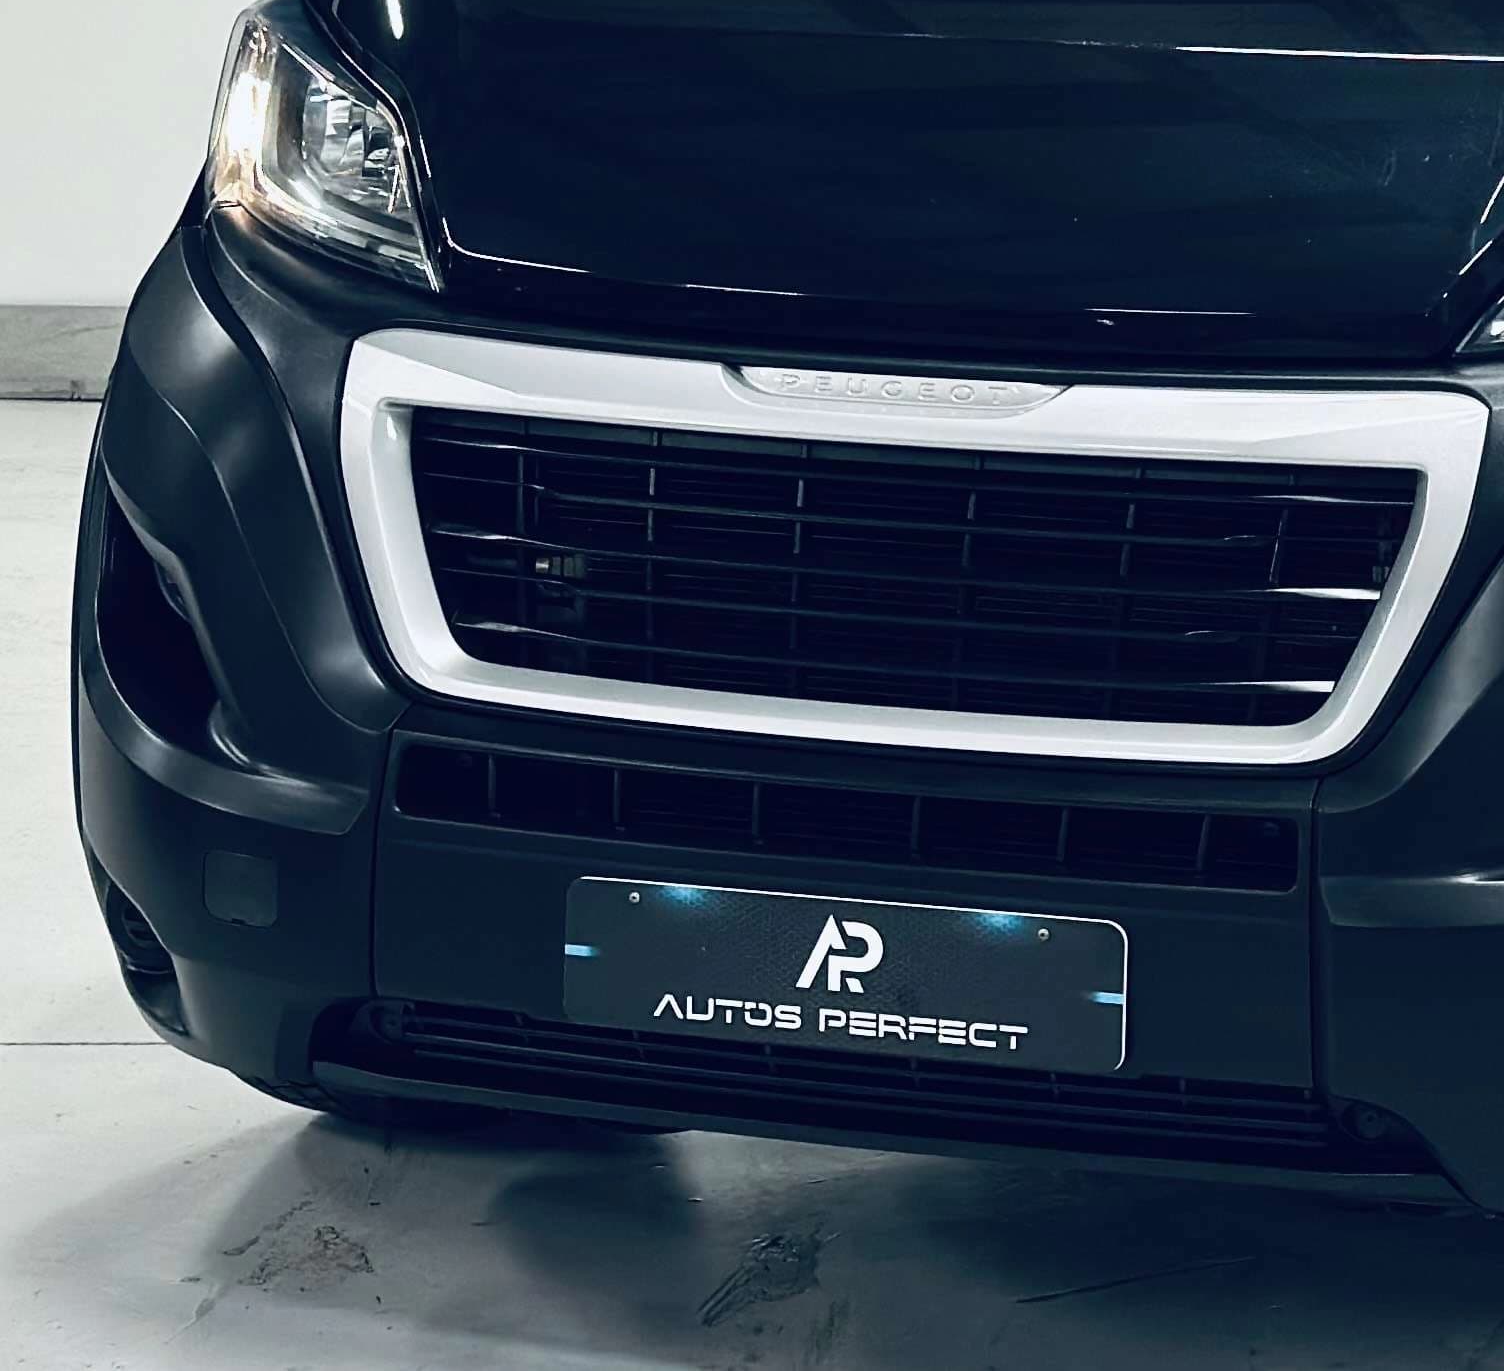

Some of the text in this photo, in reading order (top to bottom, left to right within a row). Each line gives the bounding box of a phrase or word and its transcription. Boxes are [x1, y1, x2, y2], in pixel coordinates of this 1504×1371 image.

[779, 372, 1009, 405] PEUGEOT
[653, 993, 1028, 1050] AUTOS PERFECT
